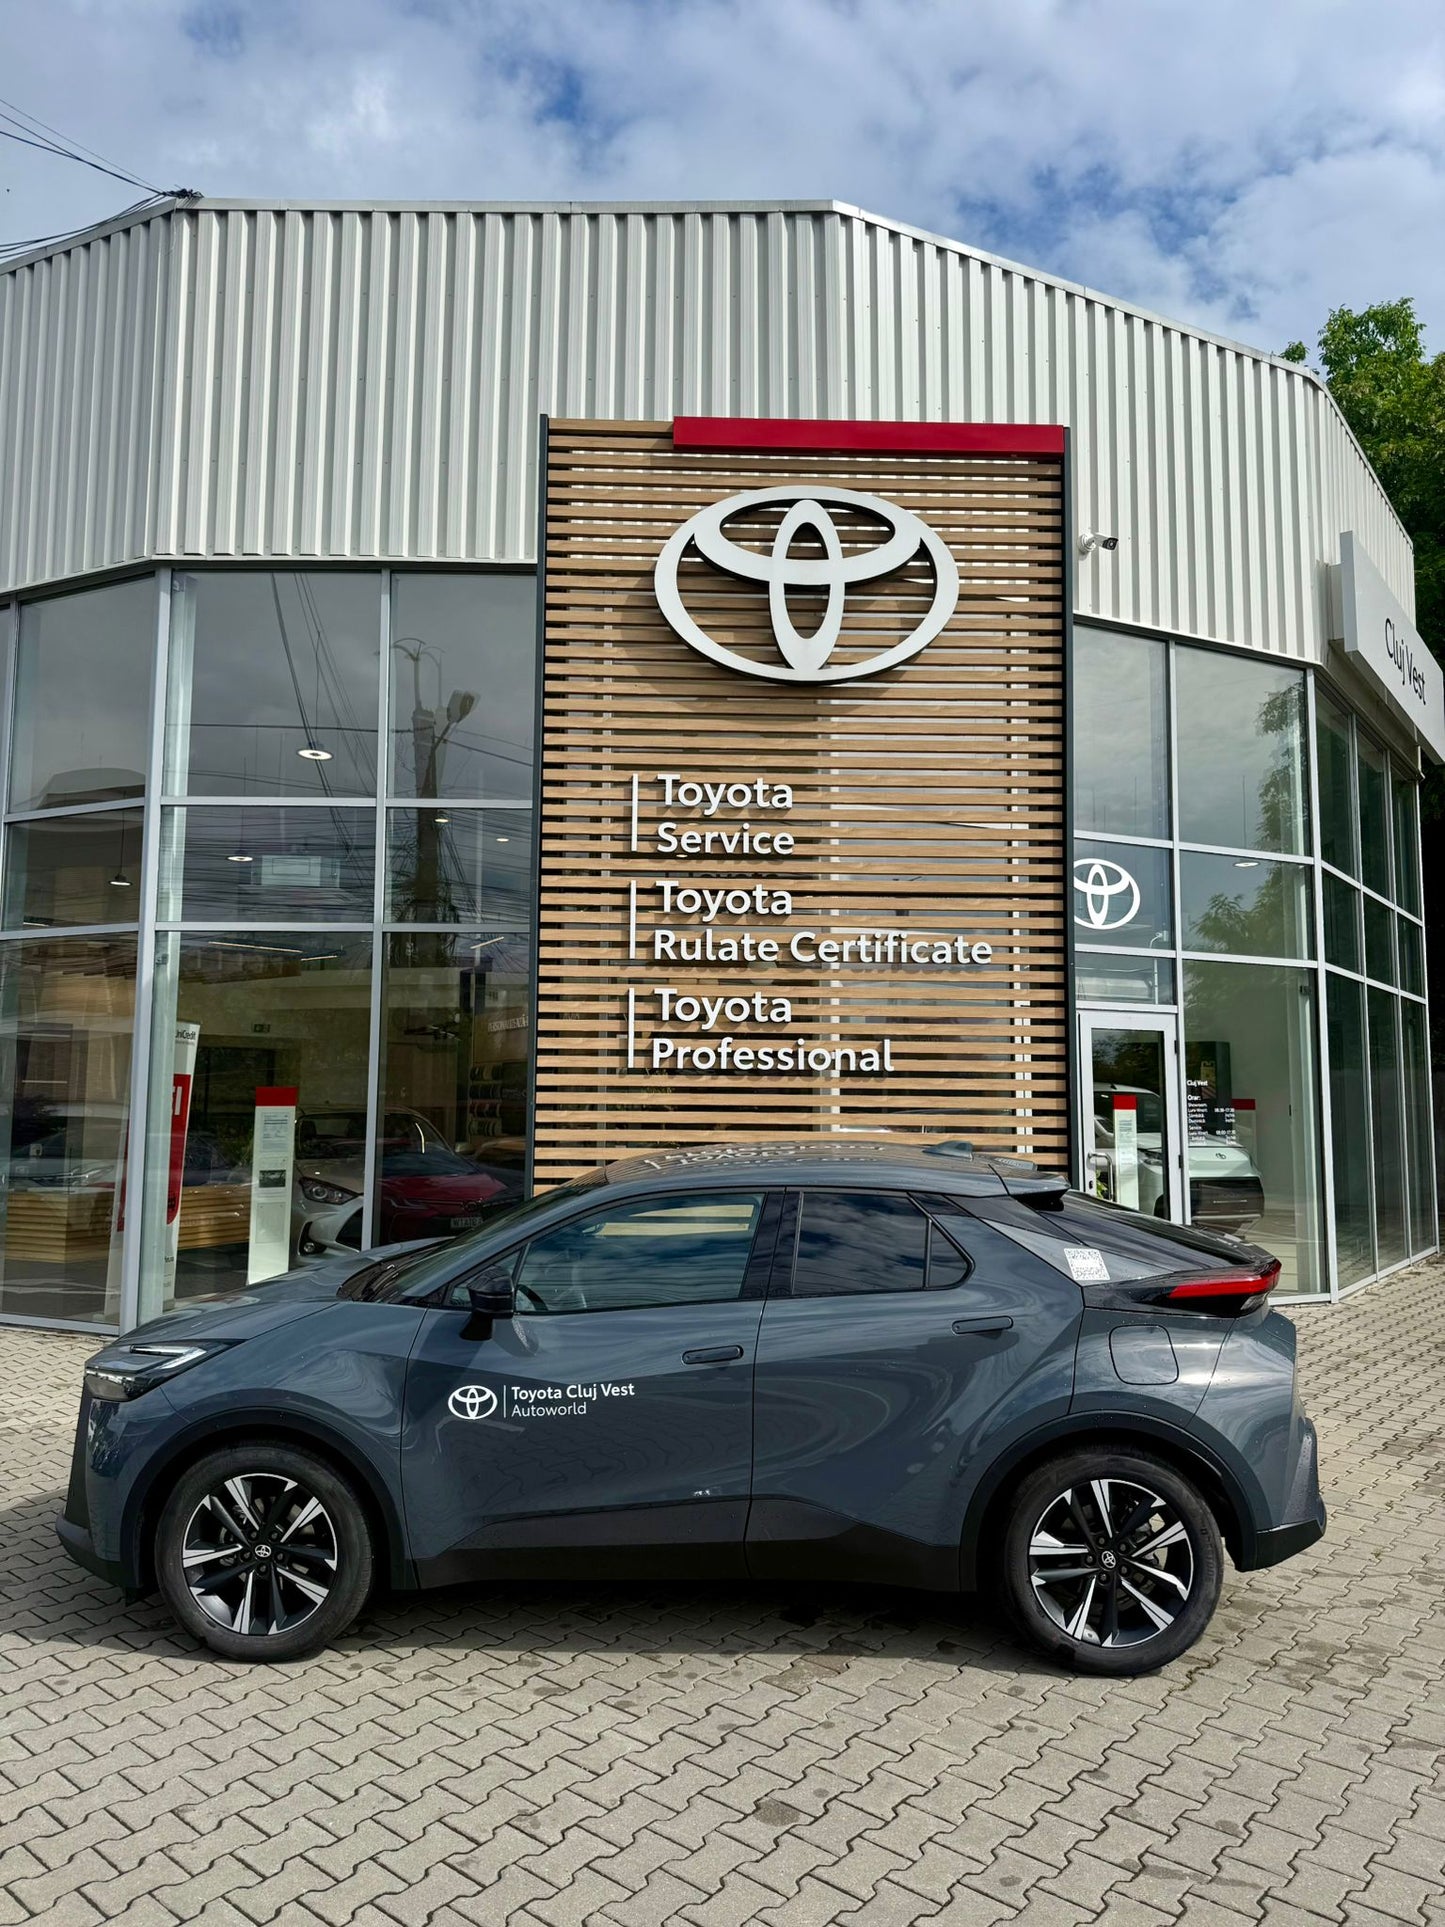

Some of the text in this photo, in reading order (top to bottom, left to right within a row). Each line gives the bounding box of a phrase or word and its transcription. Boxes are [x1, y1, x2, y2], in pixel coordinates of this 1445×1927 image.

[1385, 617, 1427, 706] Cluj Vest
[656, 773, 793, 816] Toyota
[656, 822, 795, 855] Service
[655, 880, 792, 923] Toyota
[653, 929, 993, 965] Rulate Certificate
[654, 987, 792, 1030] Toyota
[652, 1037, 895, 1072] Professional
[510, 1382, 636, 1404] Toyota Cluj Vest
[510, 1402, 588, 1418] Autoworld
